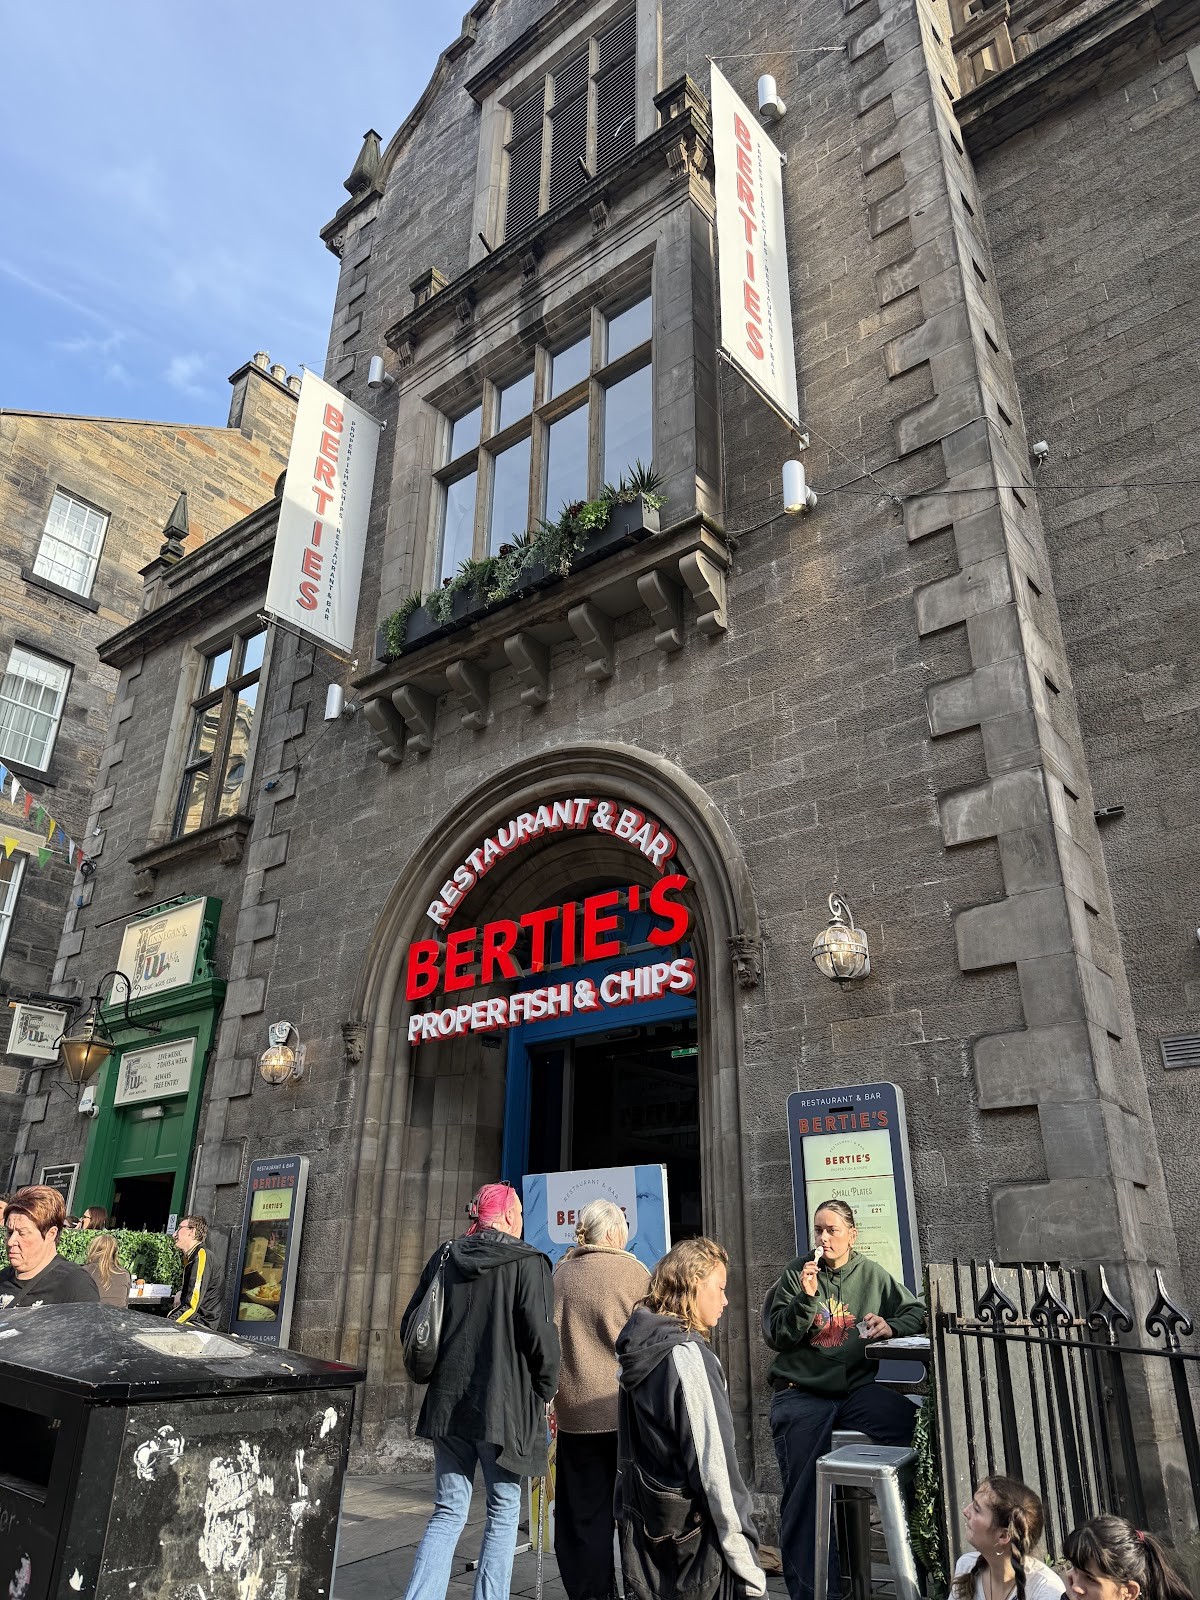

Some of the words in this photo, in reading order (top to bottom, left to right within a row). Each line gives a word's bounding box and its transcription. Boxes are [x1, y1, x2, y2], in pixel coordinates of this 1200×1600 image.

[733, 112, 765, 361] BERTIES
[346, 420, 356, 456] PROPER
[343, 457, 351, 481] FISH
[295, 402, 345, 612] BERTIES
[338, 488, 347, 519] CHIPS
[327, 527, 341, 591] RESTAURANT
[324, 600, 332, 621] BAR
[426, 797, 593, 928] RESTAURANT
[592, 800, 618, 832] &
[614, 808, 673, 869] BAR
[405, 874, 693, 1001] BERTIE'S
[407, 998, 509, 1043] PROPER
[509, 982, 572, 1024] FISH
[573, 979, 598, 1010] &
[600, 958, 693, 1004] CHIPS
[157, 1052, 168, 1061] LIVE
[168, 1050, 183, 1059] MUSIC
[160, 1061, 170, 1069] DAYS
[175, 1057, 188, 1065] WEEK
[153, 1081, 164, 1090] FREE
[164, 1078, 180, 1088] ENTRY
[154, 1072, 172, 1081] ALWAYS
[801, 1095, 853, 1108] RESTAURANT
[856, 1094, 862, 1102] &
[864, 1092, 882, 1101] BAR
[798, 1110, 890, 1134] BERTIE'S
[256, 1164, 281, 1172] RESTAURANT
[825, 1153, 871, 1166] BERTIE'S
[252, 1175, 296, 1190] BERTIE'S
[563, 1179, 600, 1202] RESTAURANT
[607, 1186, 619, 1200] BAR
[831, 1188, 851, 1199] SMALL
[851, 1186, 873, 1197] PLATES
